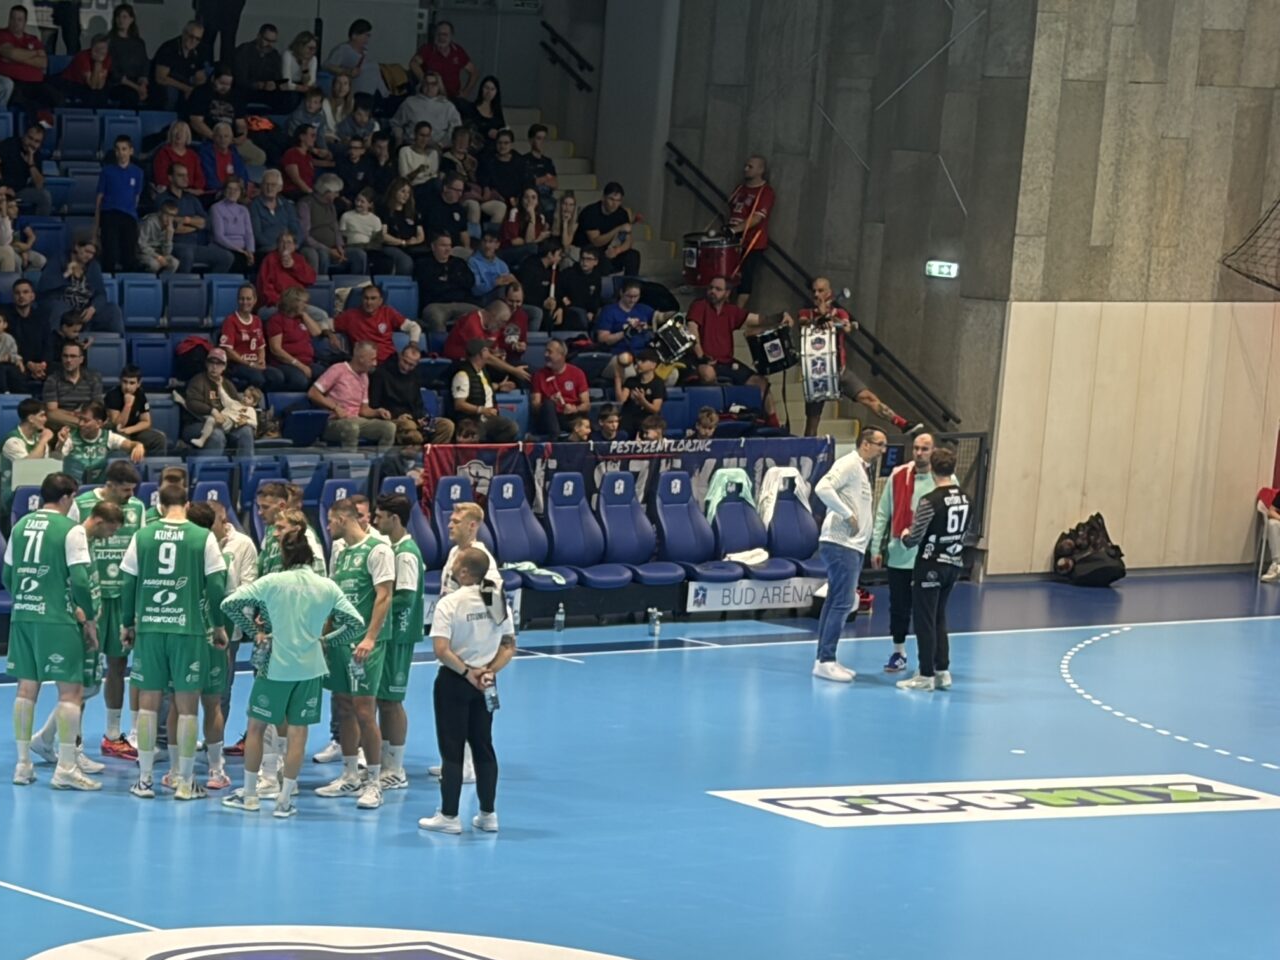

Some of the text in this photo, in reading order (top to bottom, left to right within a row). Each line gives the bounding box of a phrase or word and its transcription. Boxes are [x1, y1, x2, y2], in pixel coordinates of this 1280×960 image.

[946, 505, 969, 533] 67
[23, 530, 45, 563] 71
[158, 542, 177, 575] 9
[721, 581, 815, 606] BUD ARÉNA
